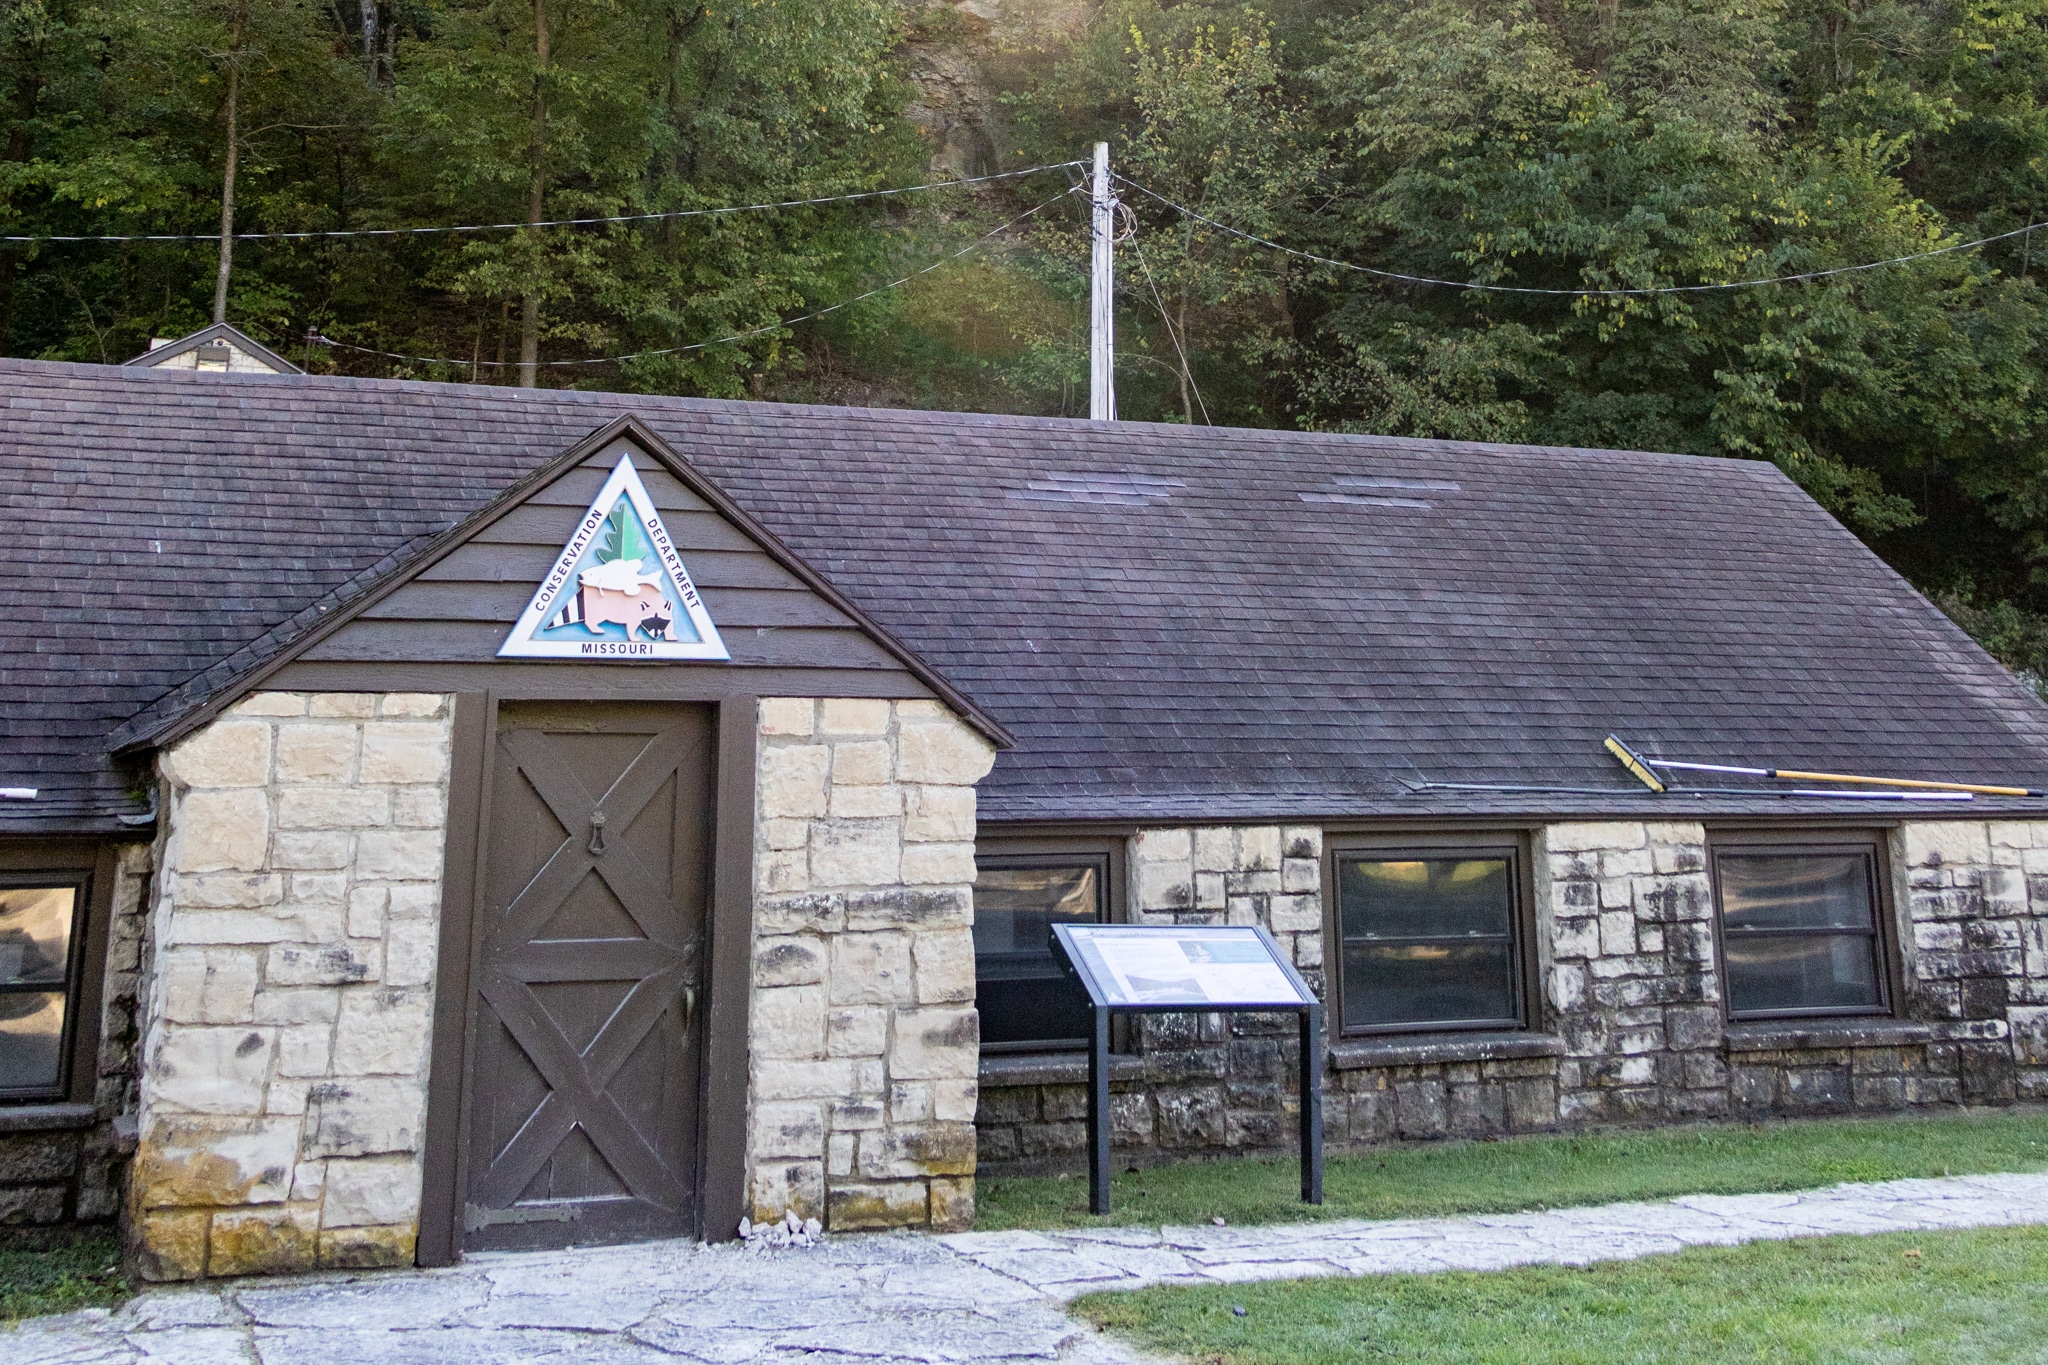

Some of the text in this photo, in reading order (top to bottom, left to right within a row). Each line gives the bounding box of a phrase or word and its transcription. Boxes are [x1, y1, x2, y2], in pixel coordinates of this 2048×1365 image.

[536, 509, 602, 611] CONSERVATION
[648, 518, 700, 609] DEPARTMENT
[581, 643, 653, 654] MISSOURI
